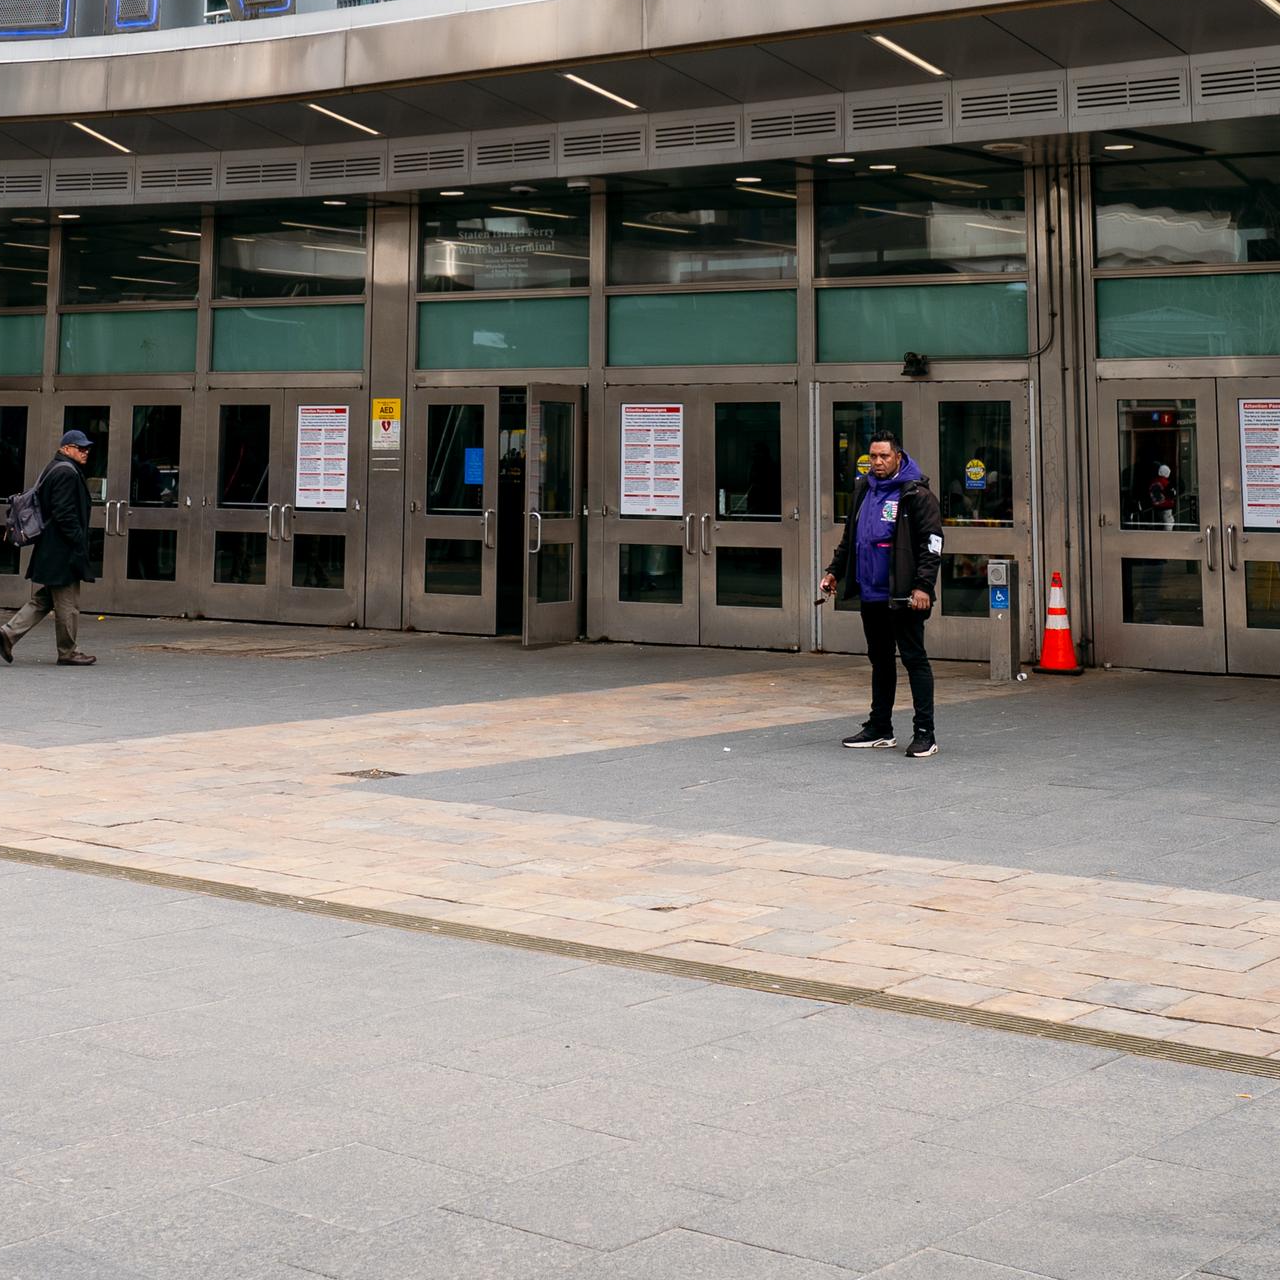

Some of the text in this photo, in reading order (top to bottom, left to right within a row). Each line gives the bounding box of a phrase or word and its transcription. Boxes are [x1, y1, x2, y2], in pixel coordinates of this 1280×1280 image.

[458, 227, 555, 240] Staten Island Ferry
[458, 241, 555, 255] Whitehall Terminal
